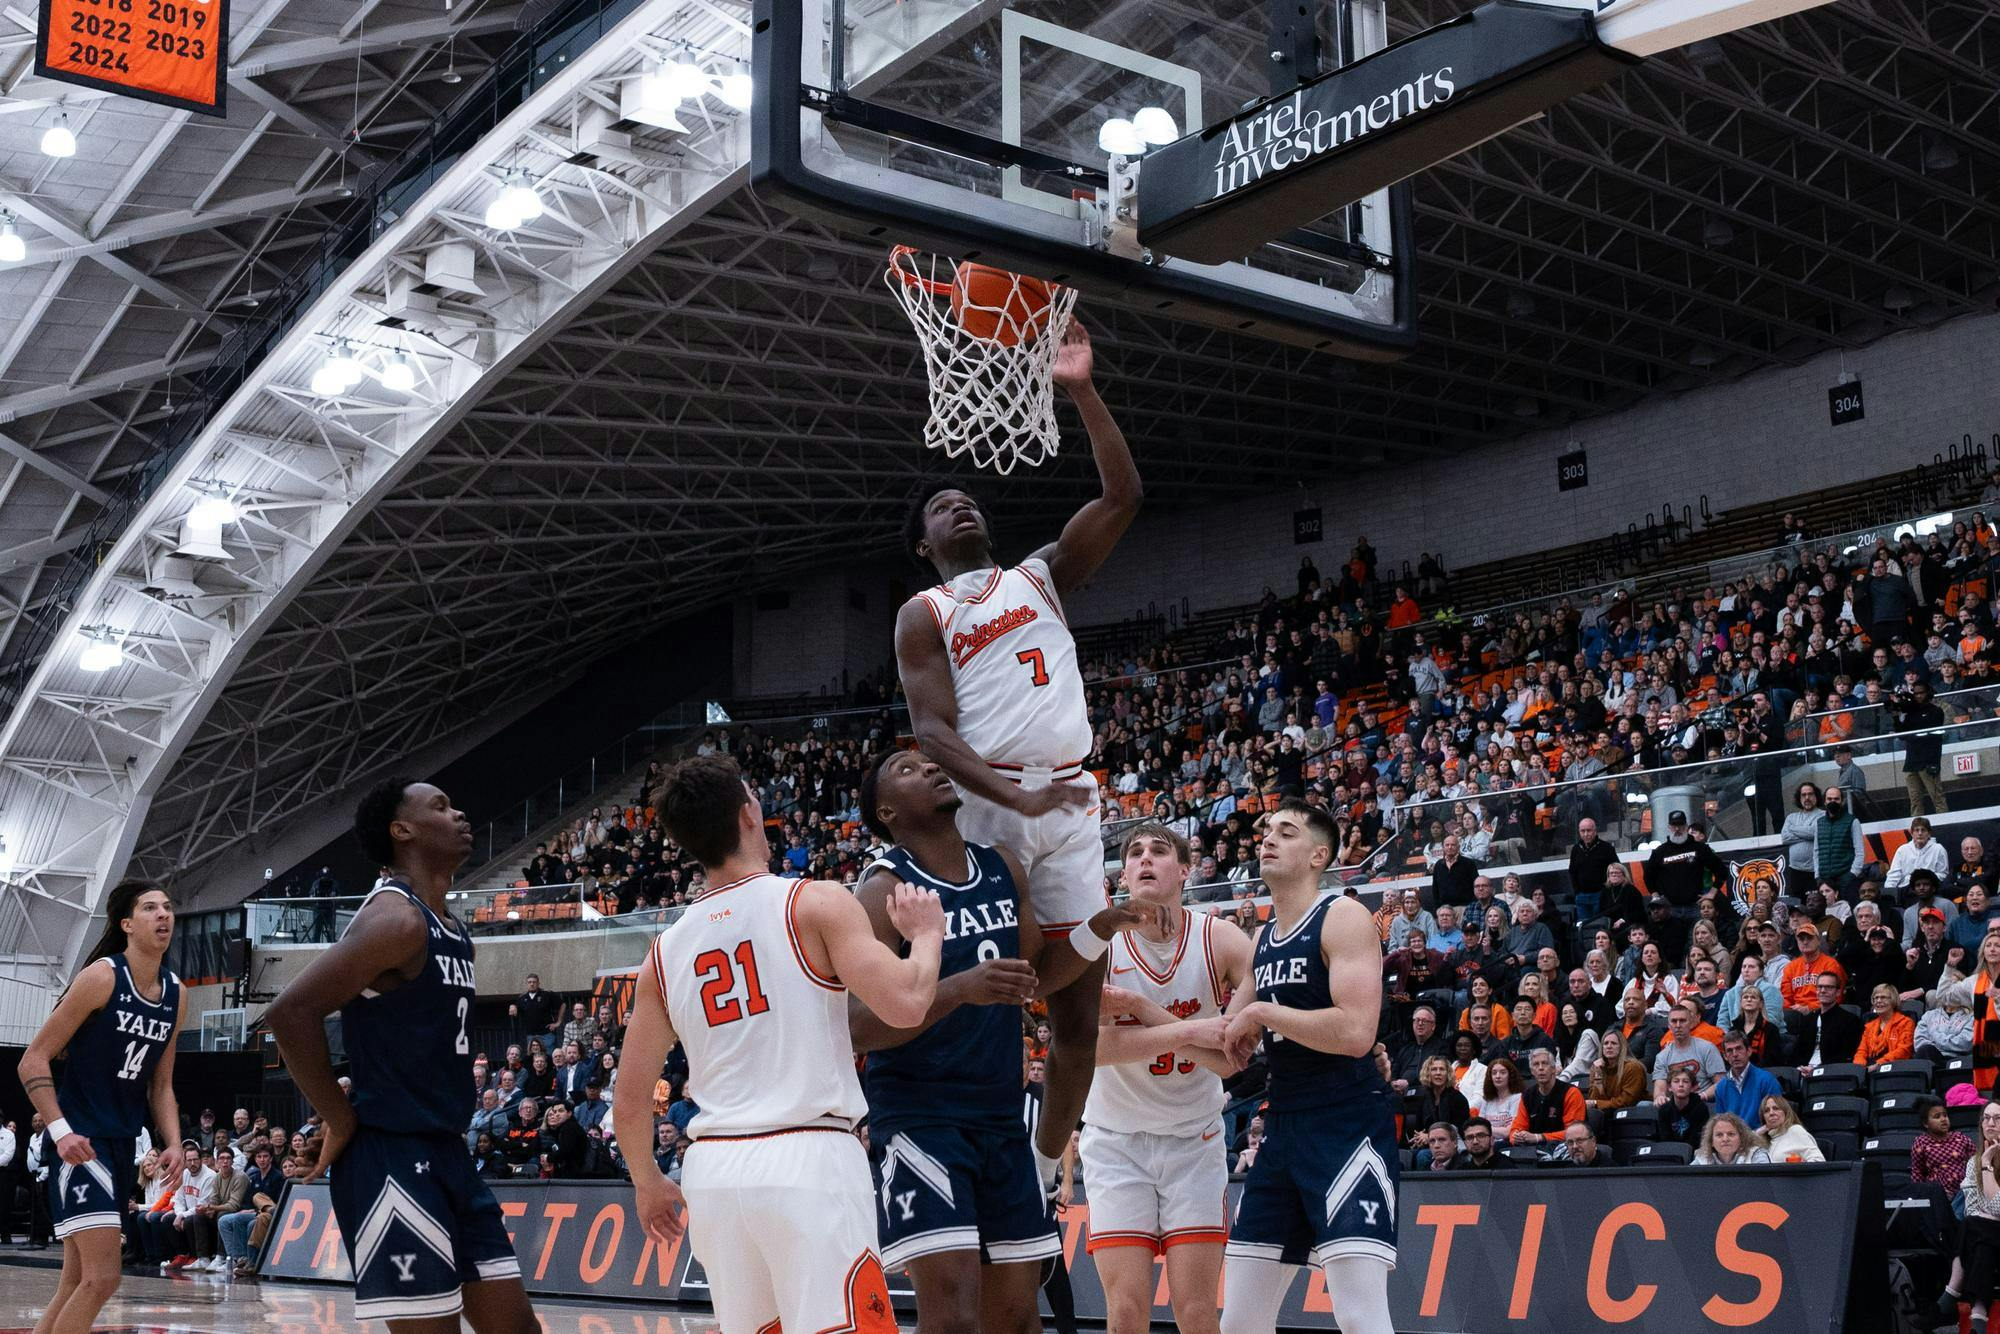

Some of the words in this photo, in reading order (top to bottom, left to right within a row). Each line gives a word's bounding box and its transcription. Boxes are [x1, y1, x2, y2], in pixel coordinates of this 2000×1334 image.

[148, 1, 206, 30] 2019
[71, 12, 131, 43] 2022
[146, 30, 204, 60] 2023
[69, 42, 129, 73] 2024
[1213, 66, 1455, 198] investments
[1215, 90, 1303, 167] Ariel
[1835, 395, 1860, 413] 304
[1563, 464, 1584, 480] 303
[1299, 520, 1320, 534] 302
[951, 605, 1038, 668] Princeton
[1016, 647, 1050, 687] 7
[1142, 676, 1157, 688] 202
[812, 718, 828, 728] 201
[1957, 754, 1974, 771] EXIT
[694, 939, 770, 1027] 21
[116, 1010, 172, 1042] YALE
[455, 997, 469, 1055] 2
[117, 1040, 150, 1080] 14
[72, 1183, 90, 1204] Y
[896, 1190, 916, 1221] Y
[1358, 1200, 1380, 1226] Y
[390, 1253, 417, 1281] Y
